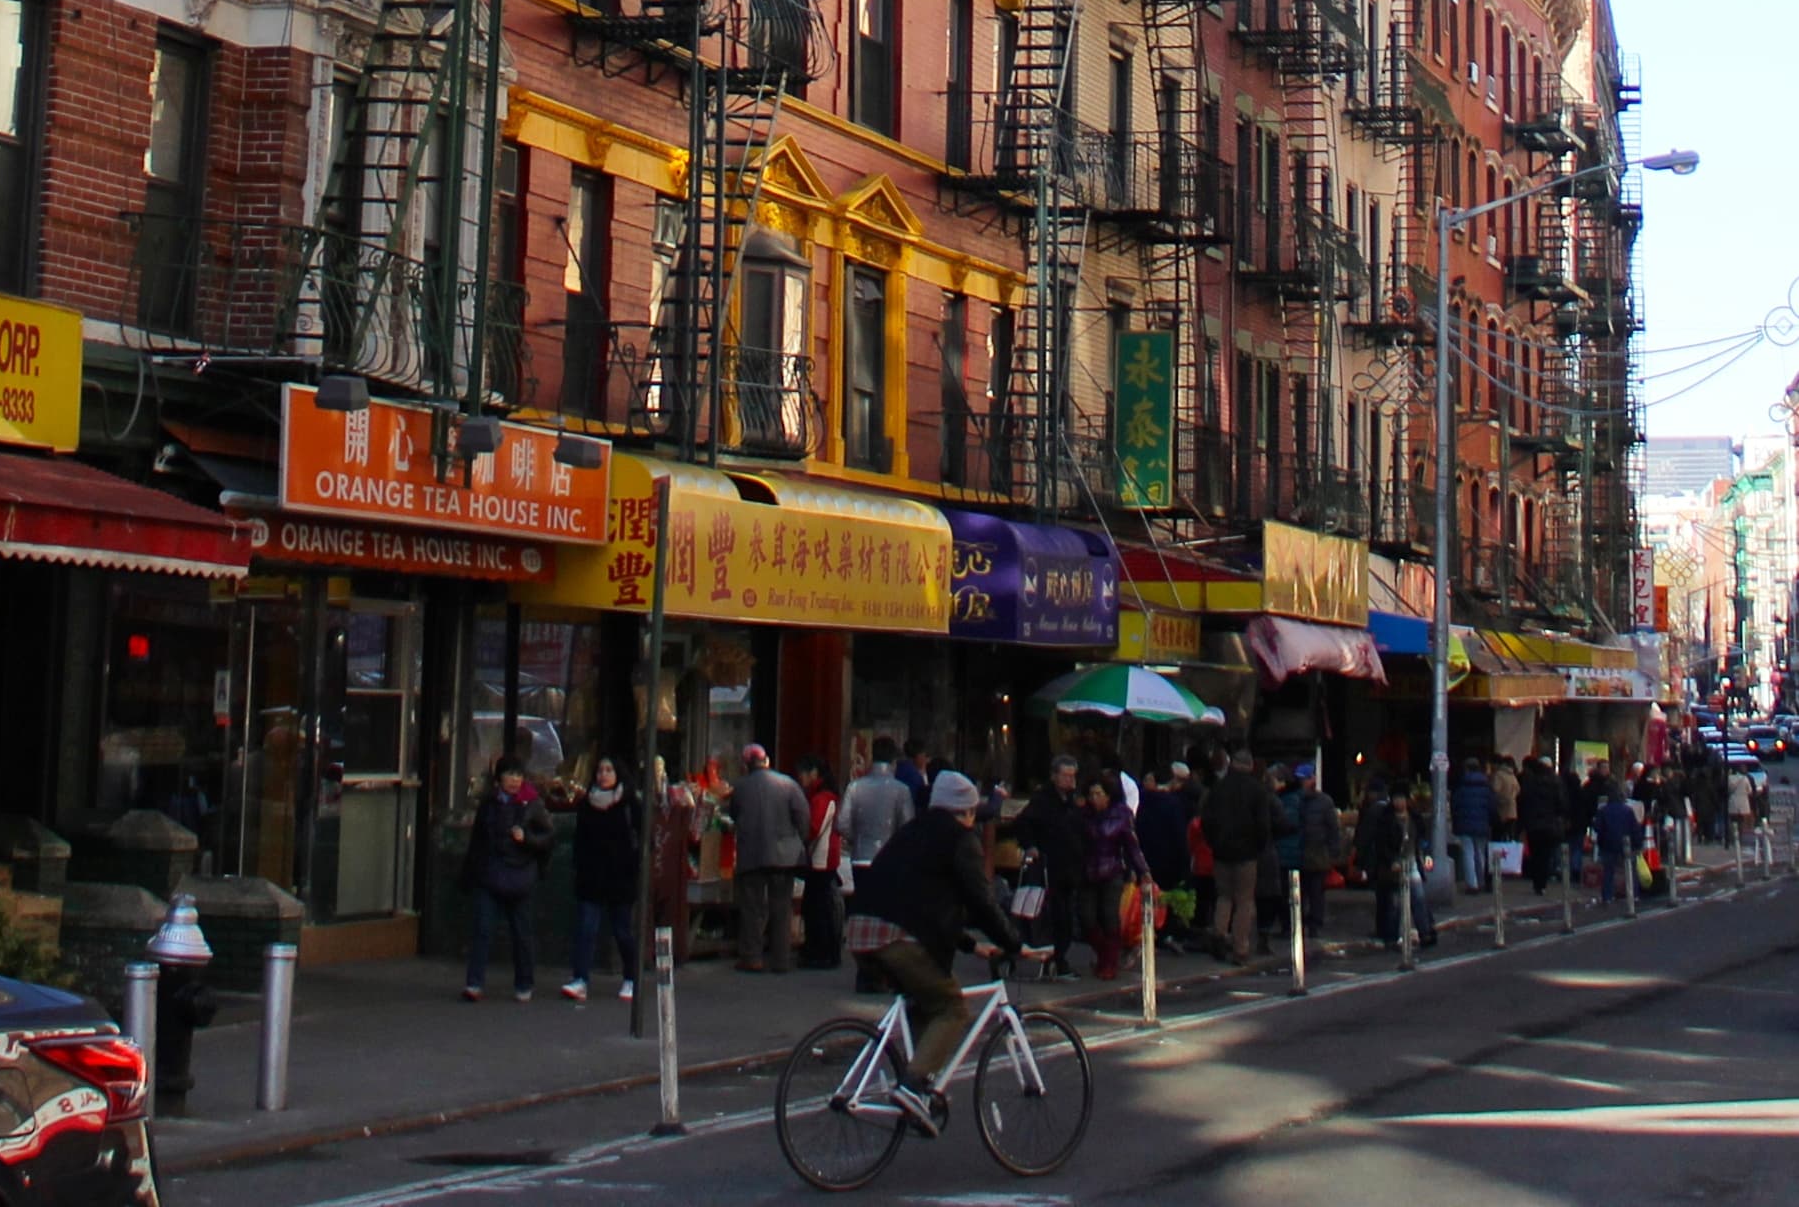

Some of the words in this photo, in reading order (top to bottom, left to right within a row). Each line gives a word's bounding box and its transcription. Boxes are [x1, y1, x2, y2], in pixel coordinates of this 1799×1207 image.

[1124, 339, 1165, 449] 永泰
[344, 407, 571, 498] 開心咖啡店
[315, 470, 414, 510] ORANGE
[422, 485, 462, 517] TEA
[469, 493, 539, 529] HOUSE
[546, 505, 587, 534] INC.
[281, 522, 364, 557] ORANGE
[371, 530, 406, 561] TEA
[412, 536, 472, 567] HOUSE
[477, 545, 513, 572] INC.
